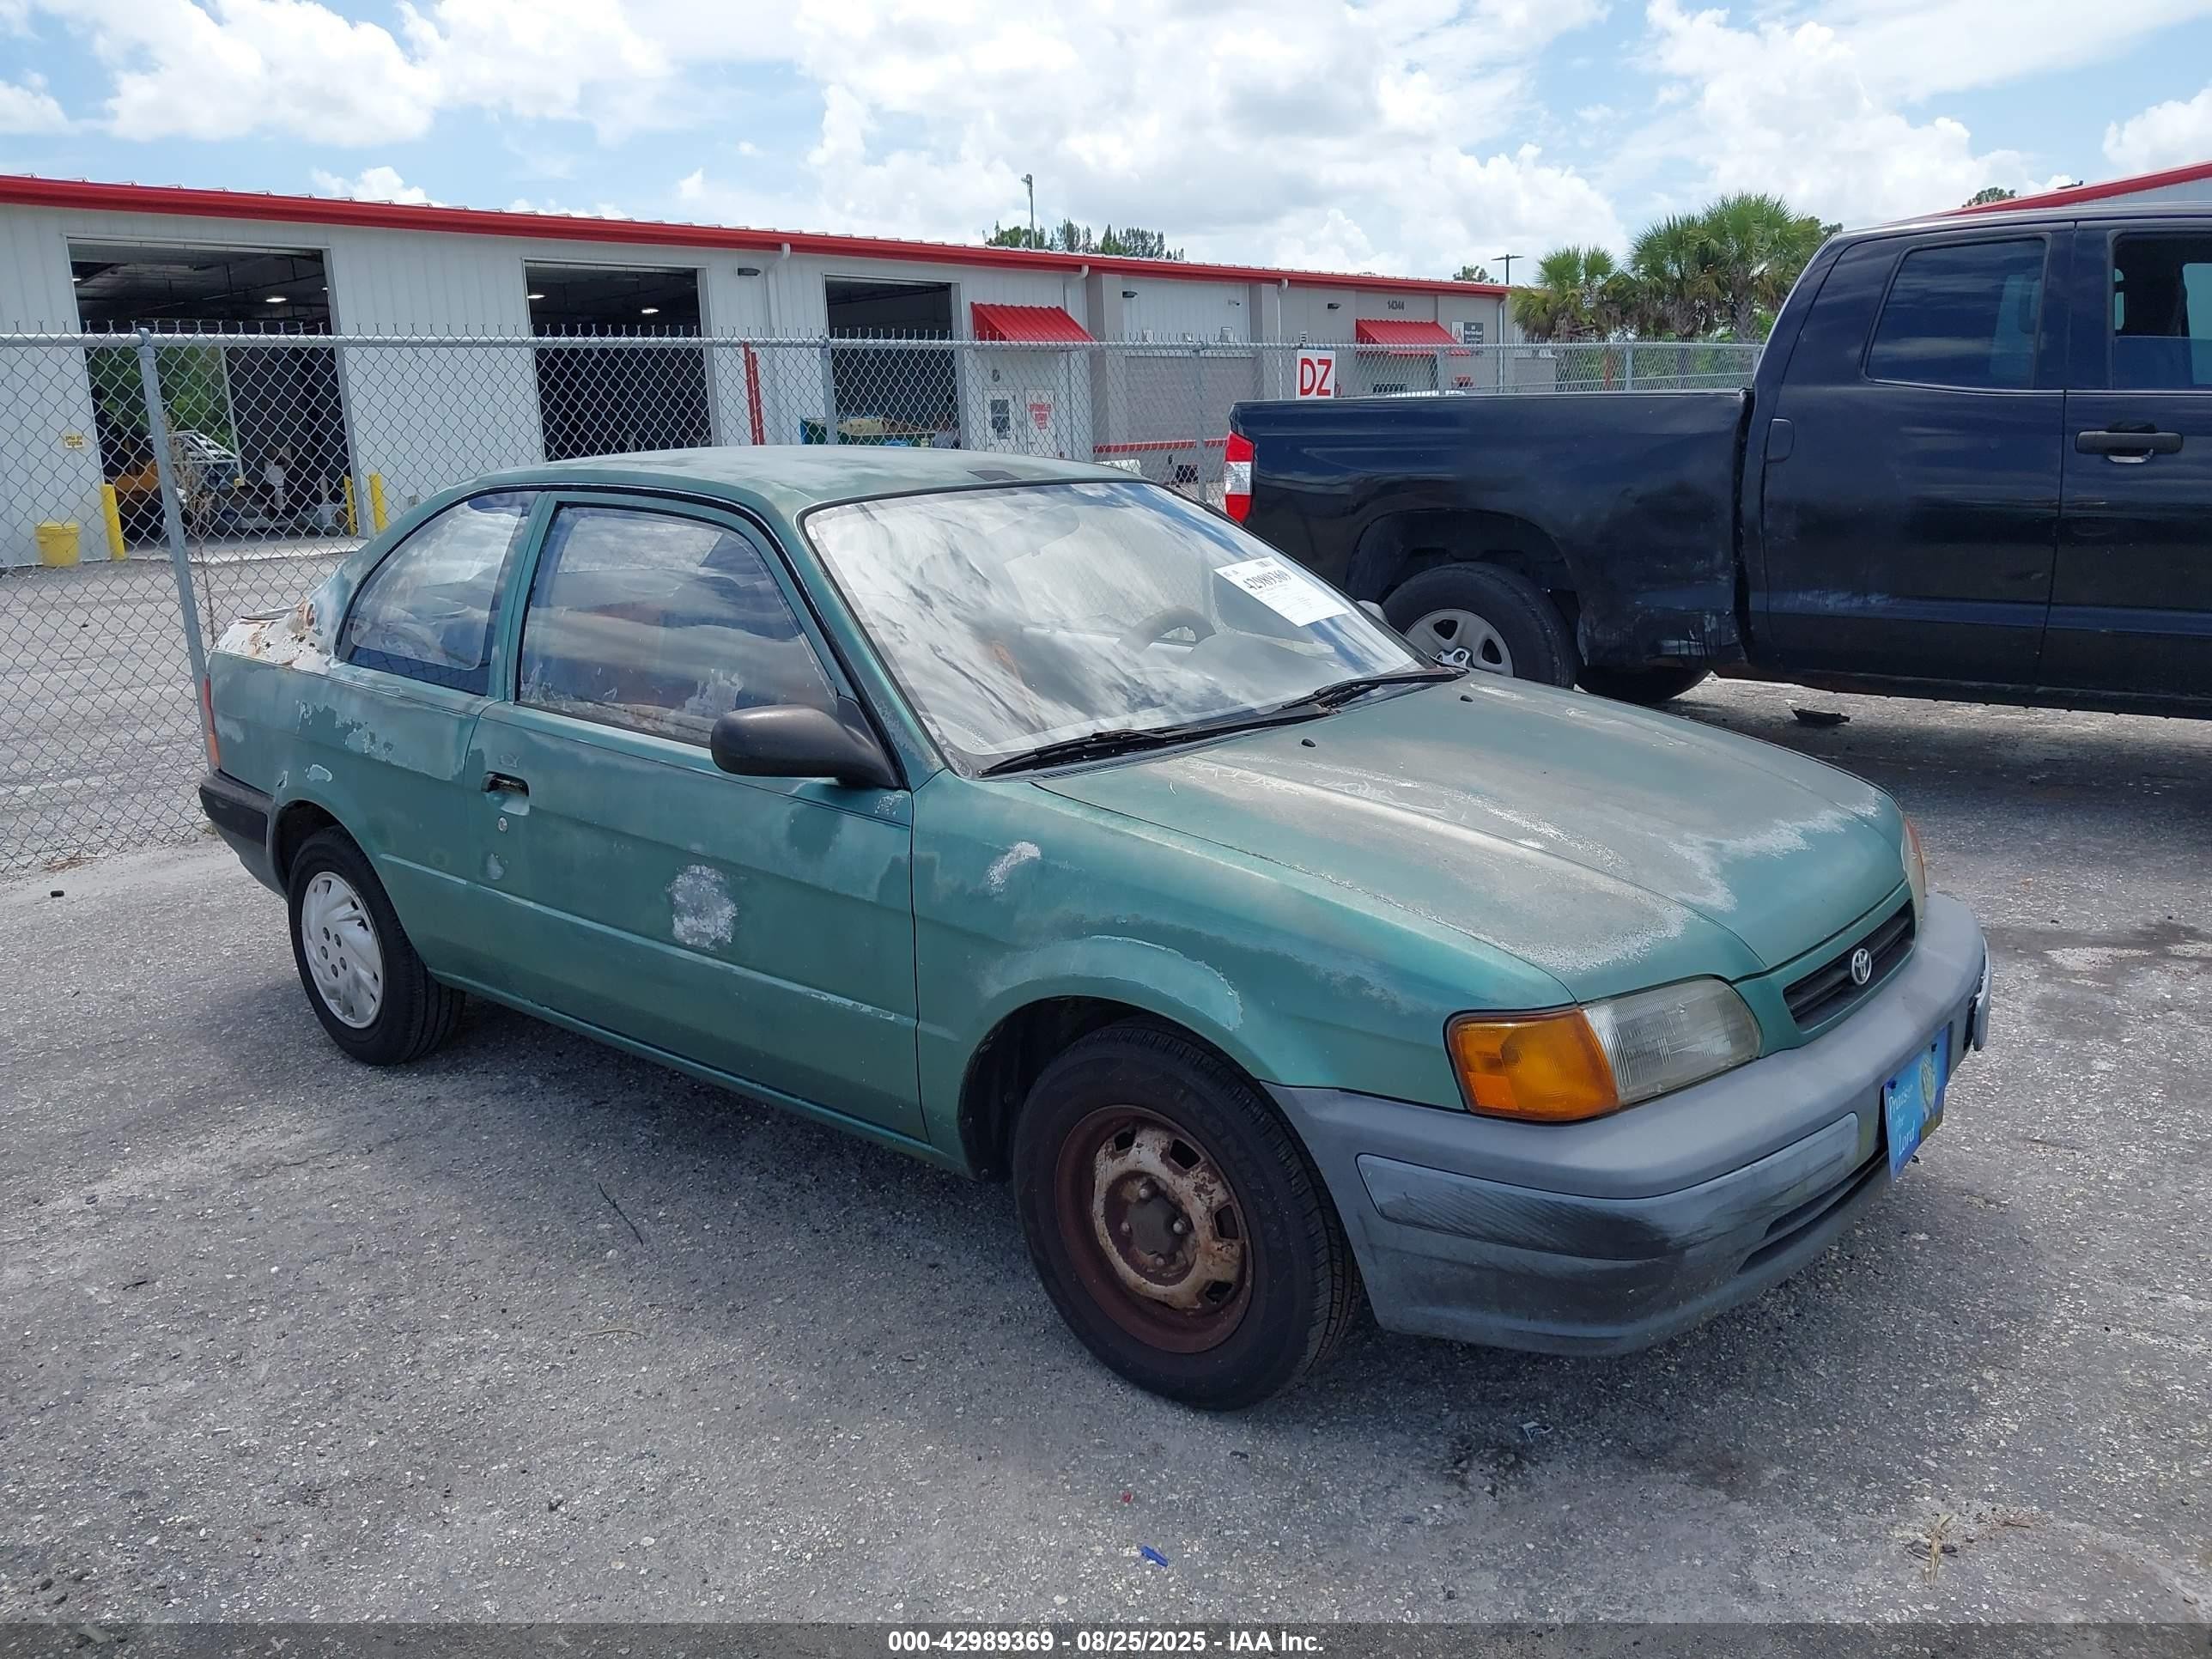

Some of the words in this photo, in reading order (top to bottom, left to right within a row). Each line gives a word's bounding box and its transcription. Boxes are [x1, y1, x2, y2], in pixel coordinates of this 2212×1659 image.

[1300, 357, 1332, 396] DZ
[1243, 569, 1291, 591] 42989369
[1889, 1085, 1914, 1121] Praise
[1899, 1119, 1916, 1156] Lord
